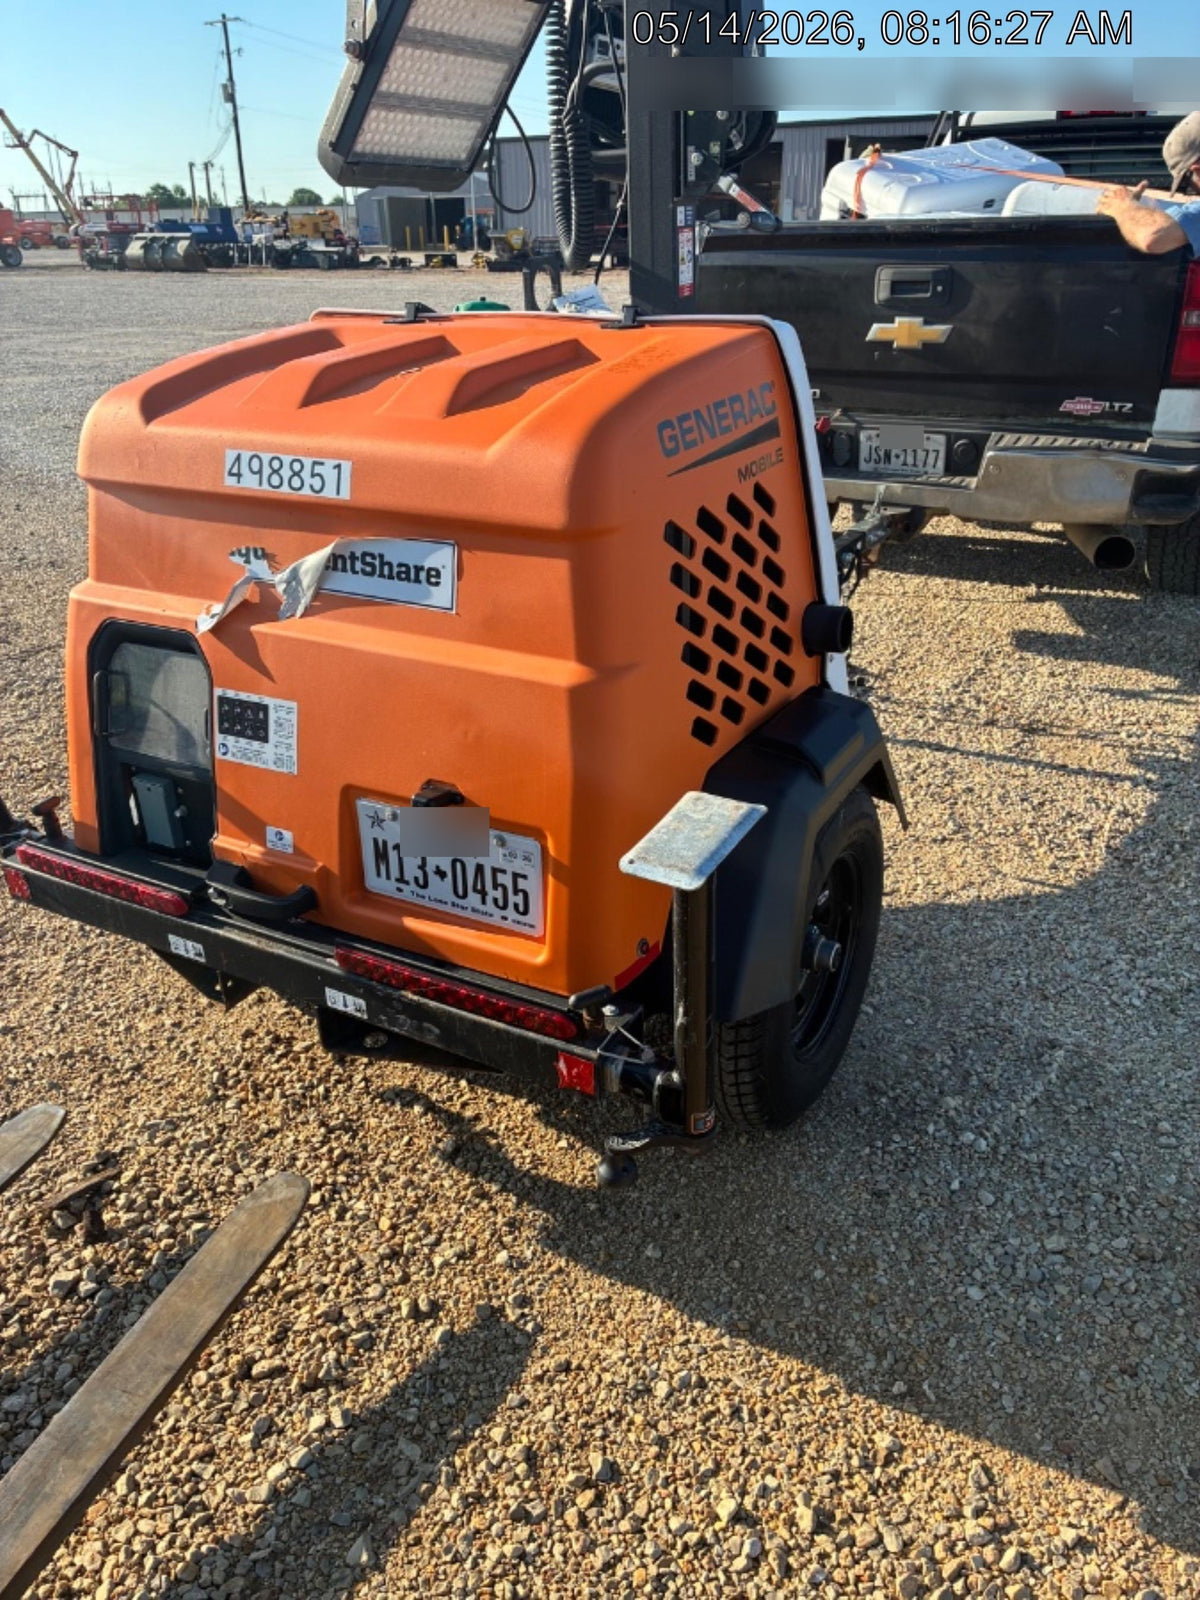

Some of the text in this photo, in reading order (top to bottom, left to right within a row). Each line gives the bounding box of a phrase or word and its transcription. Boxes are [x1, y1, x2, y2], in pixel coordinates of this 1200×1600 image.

[656, 381, 776, 459] GENERAC
[1104, 401, 1133, 413] LTZ
[227, 453, 343, 497] 498851
[737, 447, 784, 484] MOBILE
[325, 550, 441, 588] ntShare
[451, 857, 530, 916] 0455
